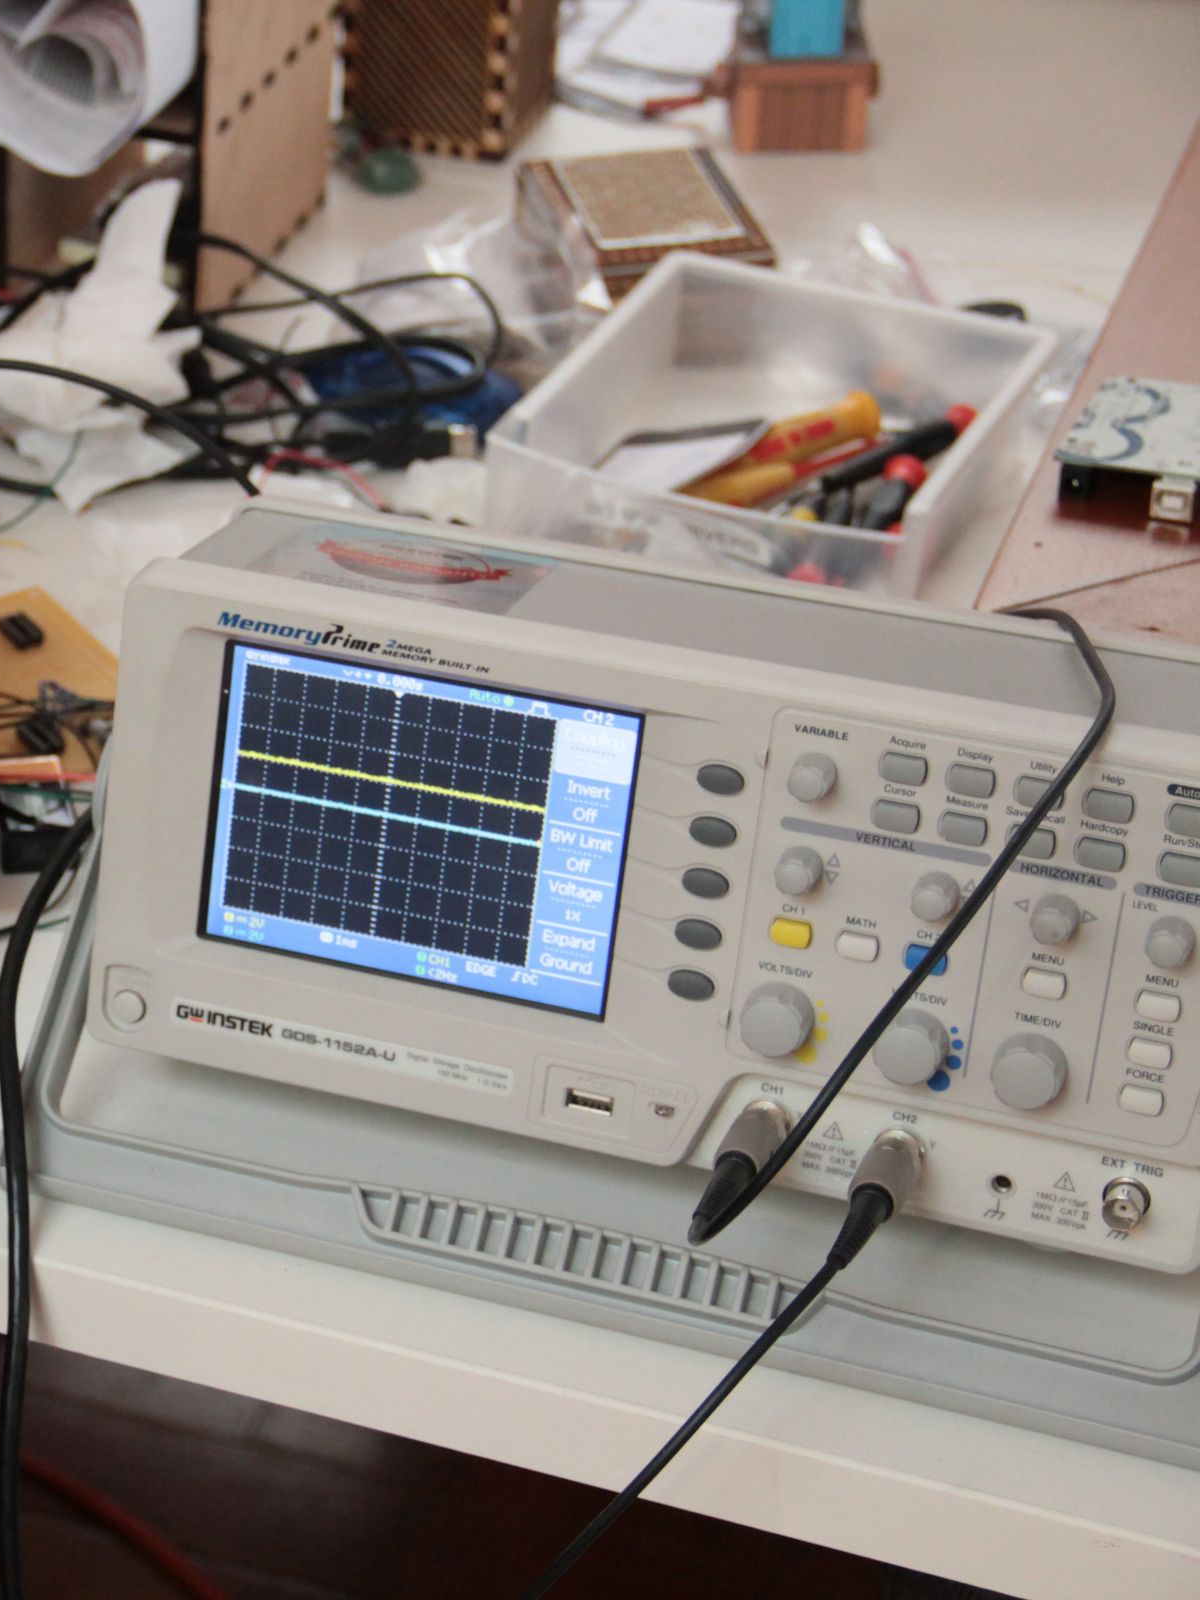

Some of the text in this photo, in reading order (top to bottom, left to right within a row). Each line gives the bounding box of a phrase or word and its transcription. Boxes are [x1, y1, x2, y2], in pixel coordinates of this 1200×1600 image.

[381, 649, 490, 674] MEMORY BUILT-IN
[469, 688, 501, 704] Auto
[794, 724, 849, 742] VARIABLE
[889, 736, 927, 751] Acquire
[957, 747, 994, 763] Display
[1030, 760, 1058, 775] Utility
[1101, 773, 1125, 786] Help
[567, 780, 612, 802] Invert
[883, 784, 917, 798] Cursor
[946, 795, 989, 811] Measure
[573, 807, 599, 825] Off
[1080, 819, 1128, 838] Hardcopy
[550, 829, 613, 854] BW Limit
[856, 831, 916, 852] VERTICAL
[566, 858, 592, 874] Off
[1020, 862, 1104, 887] HORIZONTAL
[549, 879, 604, 903] Voltage
[782, 903, 798, 914] CH
[1132, 900, 1158, 912] LEVEL
[565, 910, 581, 922] 1X
[846, 915, 877, 929] MATH
[542, 929, 596, 953] Expand
[916, 929, 933, 940] CH
[428, 953, 451, 968] CH1
[540, 953, 593, 975] Ground
[1032, 952, 1064, 966] MENU
[465, 961, 496, 978] EDGE
[758, 961, 813, 979] VOLTS/DIV
[1145, 974, 1179, 988] MENU
[1014, 1011, 1062, 1029] TIME/DIV
[1133, 1020, 1175, 1037] SINGLE
[281, 1028, 397, 1062] GDS-1152A-U
[1126, 1067, 1166, 1084] FORCE
[761, 1082, 784, 1095] CH1
[892, 1111, 918, 1124] CH2
[829, 1156, 846, 1167] CAT
[1101, 1156, 1164, 1178] EXT TRIG
[1060, 1207, 1078, 1218] CAT
